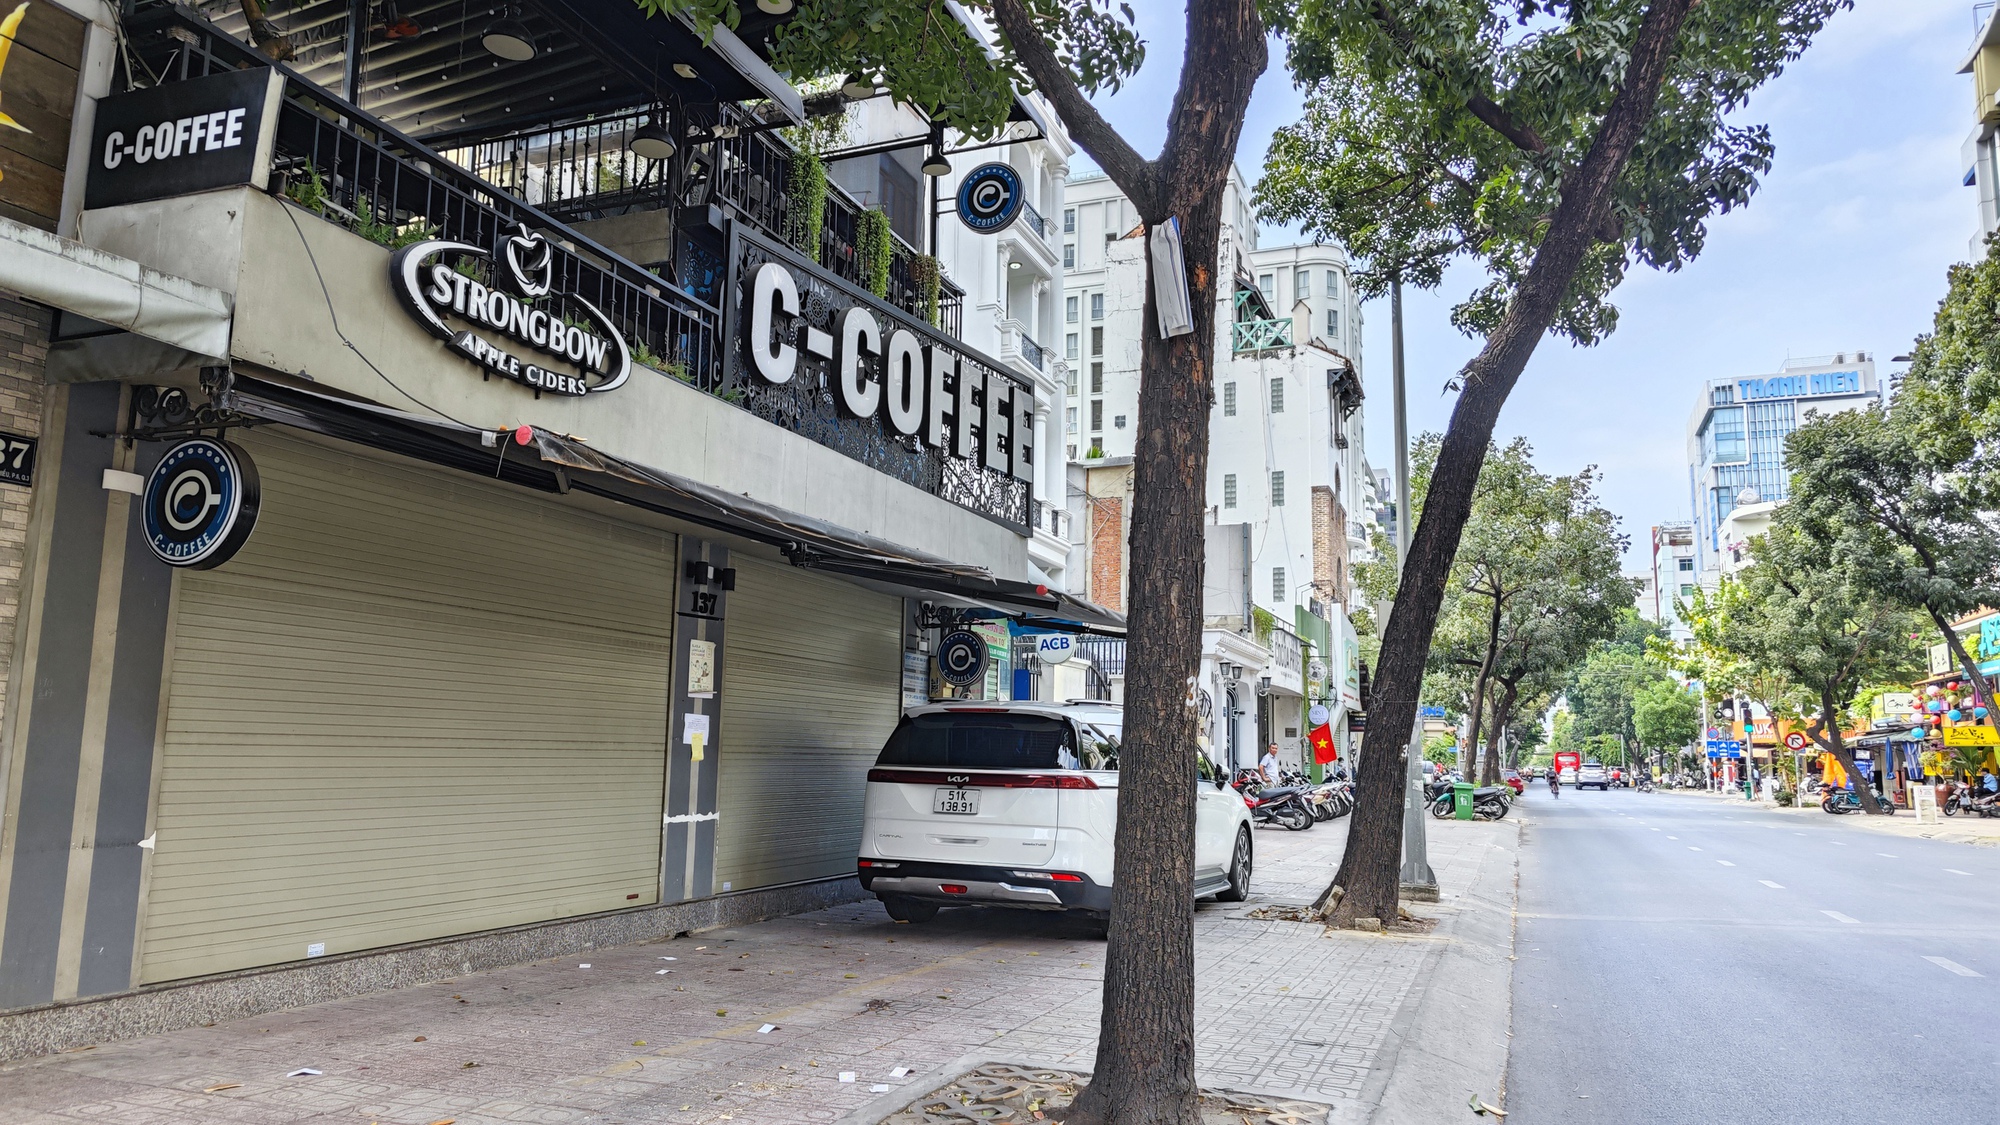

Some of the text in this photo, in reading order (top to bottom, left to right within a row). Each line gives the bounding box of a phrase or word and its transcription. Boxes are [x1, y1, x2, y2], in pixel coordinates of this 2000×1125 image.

[103, 107, 246, 170] C-COFFEE
[967, 212, 1006, 227] C-COFFEE
[429, 263, 608, 372] STRONGBOW
[461, 332, 587, 396] APPLE CIDERS
[749, 262, 1034, 484] C-COFFEE
[1738, 375, 1807, 401] THANH
[154, 533, 211, 557] C-COFFEE
[691, 591, 718, 615] 137
[1040, 637, 1070, 651] ACB
[940, 801, 973, 813] 138.91
[948, 790, 967, 801] 51K
